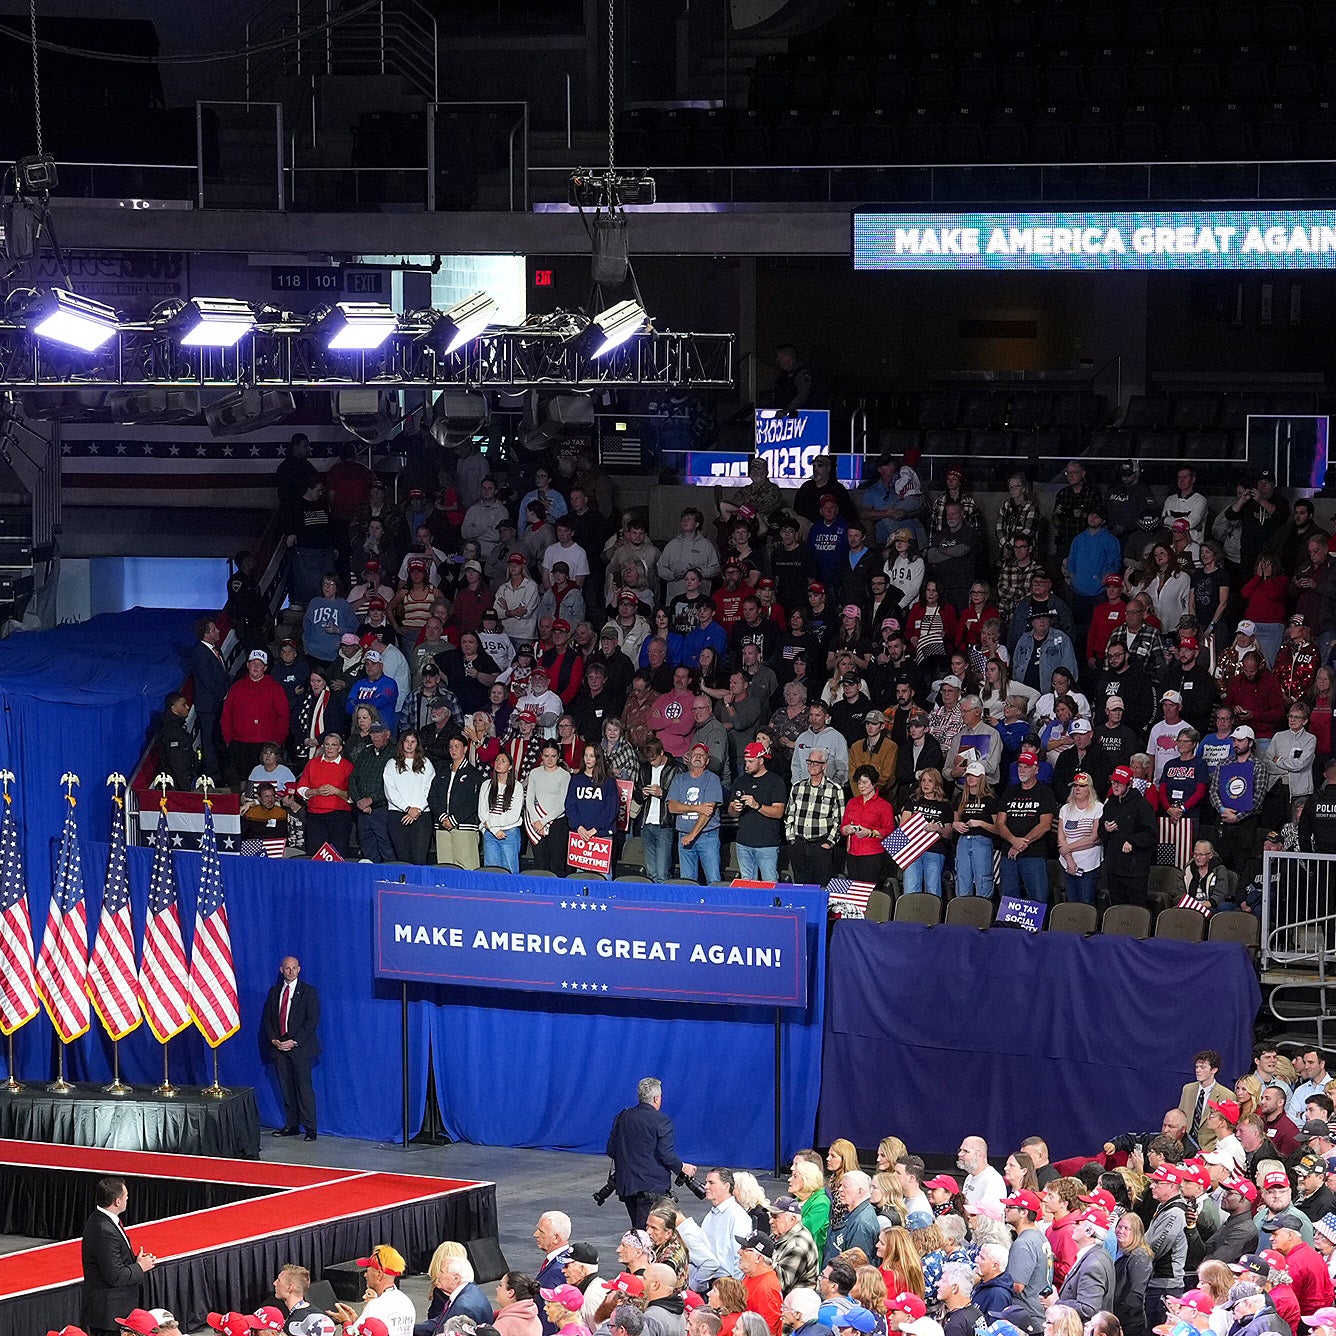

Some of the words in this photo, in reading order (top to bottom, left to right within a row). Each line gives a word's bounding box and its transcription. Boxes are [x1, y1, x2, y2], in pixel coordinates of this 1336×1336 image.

[894, 227, 979, 254] MAKE
[986, 227, 1125, 254] AMERICA
[1132, 226, 1236, 254] GREAT
[313, 607, 339, 626] USA
[481, 641, 506, 651] USA
[1166, 766, 1195, 779] USA
[576, 786, 603, 801] USA
[619, 788, 628, 803] NO
[571, 839, 586, 850] NO
[588, 841, 609, 854] TAX
[319, 848, 334, 862] NO
[568, 854, 609, 868] OVERTIME
[1008, 902, 1022, 911] NO
[1024, 904, 1039, 915] TAX
[1005, 914, 1035, 927] SOCIAL
[395, 924, 463, 948] MAKE
[472, 930, 586, 956] AMERICA
[597, 938, 680, 961] GREAT
[690, 943, 781, 967] AGAIN!
